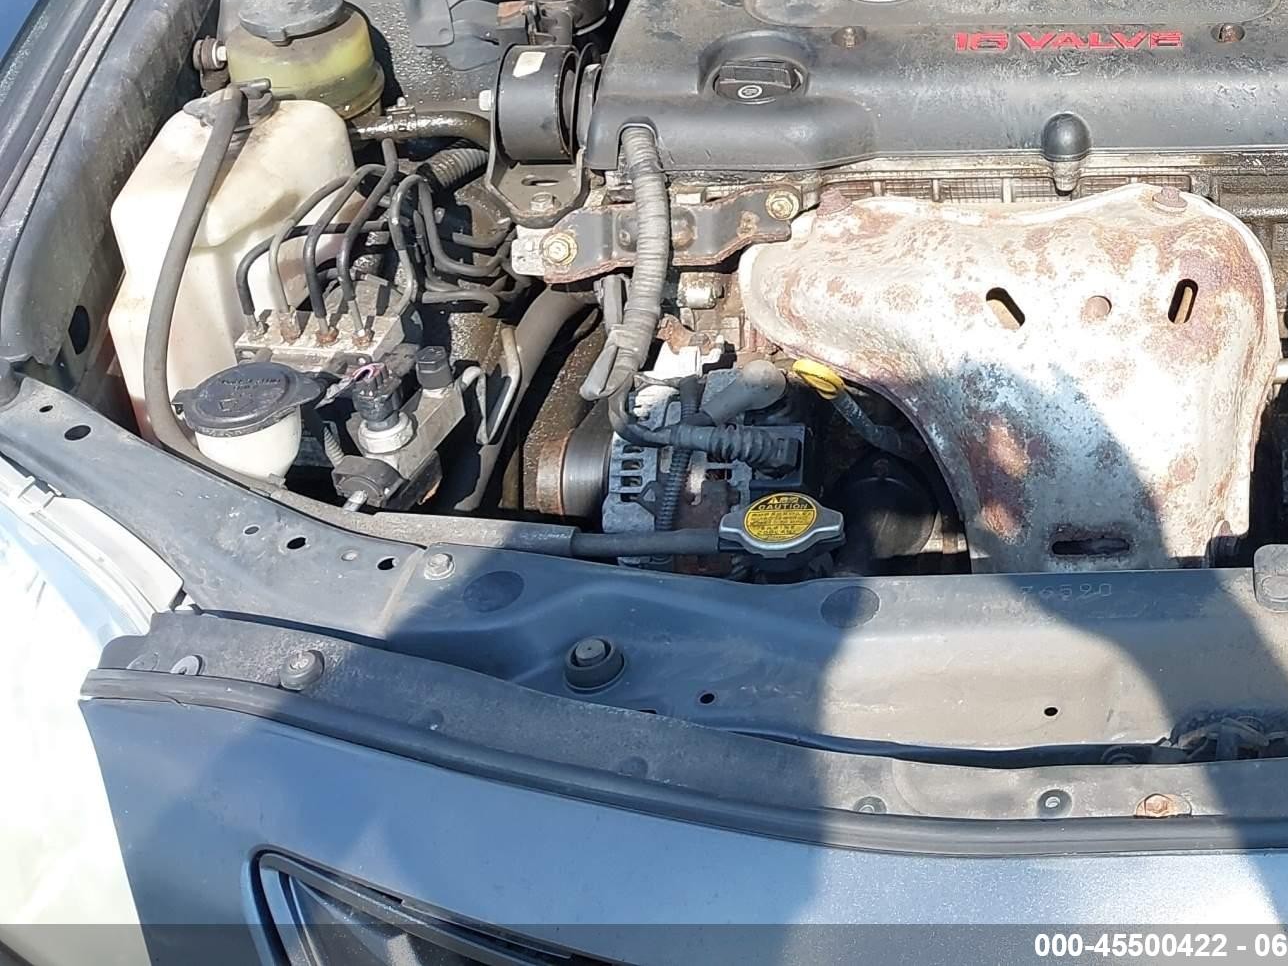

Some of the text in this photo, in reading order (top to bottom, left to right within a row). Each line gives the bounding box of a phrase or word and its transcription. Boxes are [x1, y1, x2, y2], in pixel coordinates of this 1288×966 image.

[955, 32, 1184, 52] 16 VALVE
[758, 503, 809, 511] CAUTION
